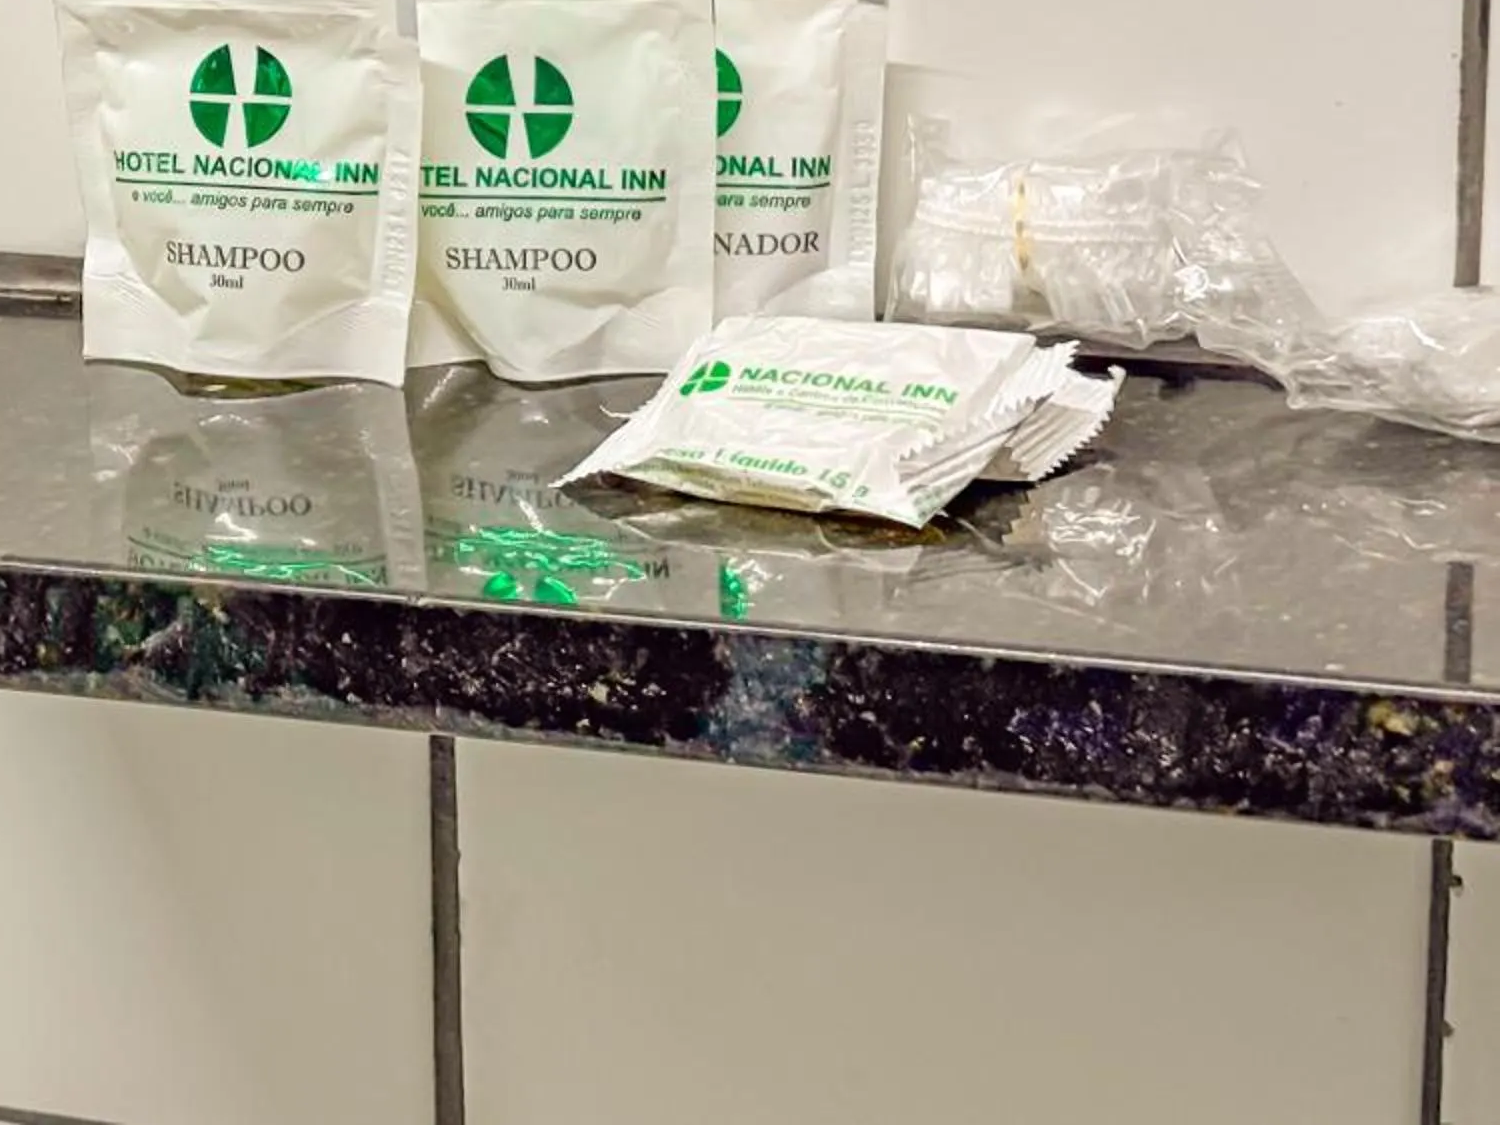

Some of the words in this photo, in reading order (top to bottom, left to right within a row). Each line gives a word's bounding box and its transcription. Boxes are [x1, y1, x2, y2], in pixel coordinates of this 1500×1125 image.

[113, 150, 185, 174] HOTEL
[335, 162, 379, 185] INN
[420, 165, 468, 188] TEL
[475, 166, 612, 190] NACIONAL
[621, 169, 667, 191] INN
[791, 154, 832, 178] INN
[190, 190, 248, 211] amigos
[250, 195, 288, 213] para
[292, 198, 354, 216] sempre
[475, 204, 533, 222] amigos
[536, 206, 575, 223] para
[579, 208, 642, 224] sempre
[716, 194, 745, 207] ara
[749, 194, 812, 212] sempre
[166, 239, 306, 273] SHAMPOO
[444, 246, 598, 273] SHAMPOO
[209, 273, 244, 290] 30ml
[501, 276, 537, 292] 30ml
[739, 366, 893, 394] NACIONAL
[901, 383, 960, 405] INN
